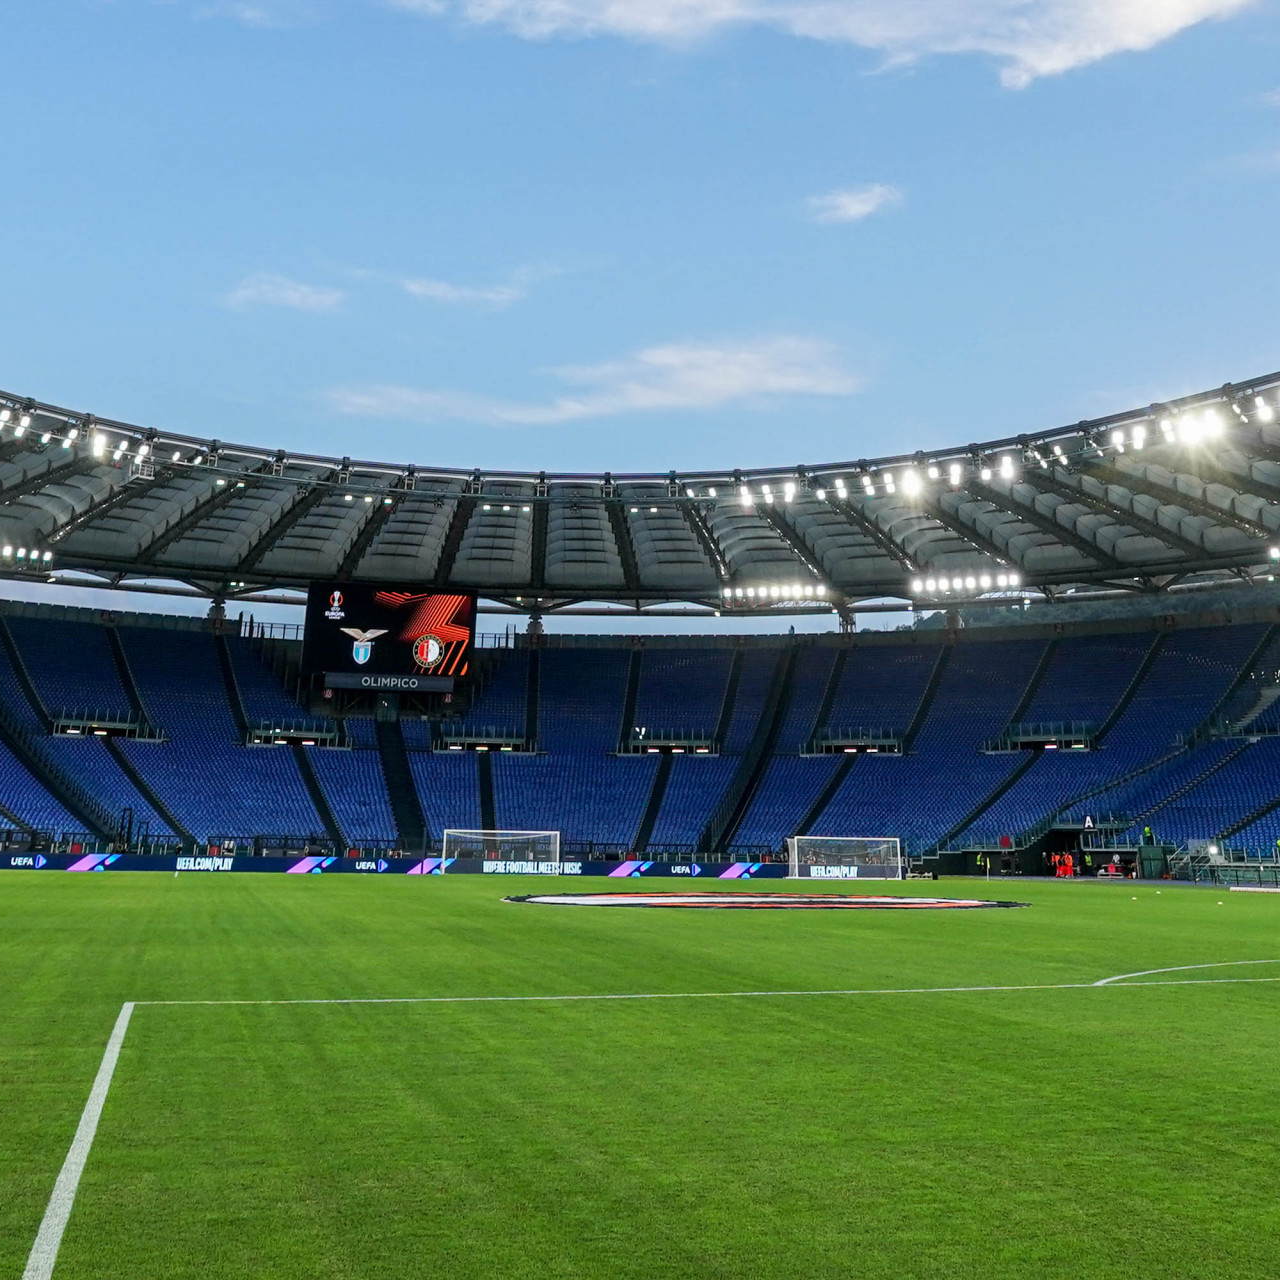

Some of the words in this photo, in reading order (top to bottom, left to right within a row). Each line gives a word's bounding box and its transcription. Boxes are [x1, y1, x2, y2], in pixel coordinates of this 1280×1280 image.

[361, 676, 419, 688] OLIMPICO
[1084, 815, 1094, 828] A
[10, 856, 34, 866] UEFA
[176, 856, 234, 871] UEFA.COM/PLAY
[355, 861, 377, 870] UEFA
[506, 861, 538, 874] FOOTBALL
[538, 861, 560, 874] MEETS
[671, 865, 691, 874] UEFA
